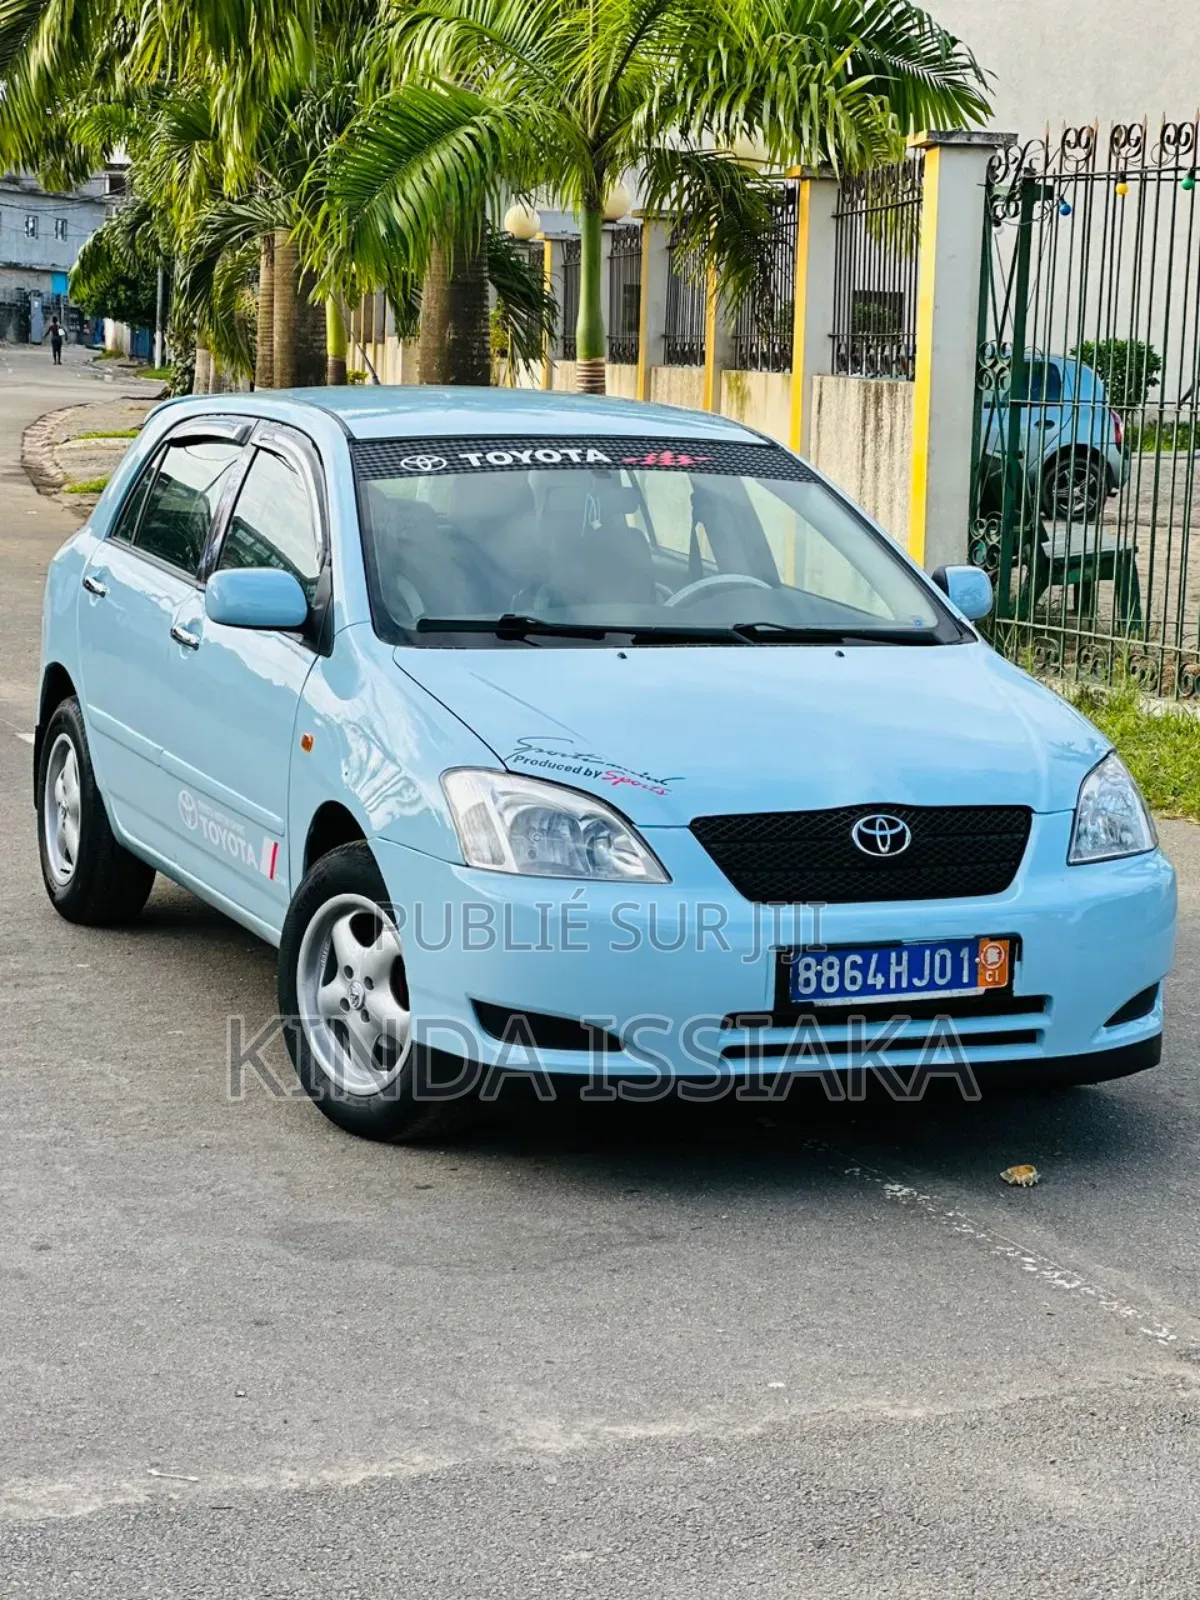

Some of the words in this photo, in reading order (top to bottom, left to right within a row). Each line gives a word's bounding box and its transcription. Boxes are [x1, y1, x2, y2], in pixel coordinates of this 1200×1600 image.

[459, 450, 611, 466] TOYOTA
[513, 755, 580, 775] Produced
[583, 768, 602, 779] by
[602, 770, 672, 795] Sports
[199, 815, 258, 871] TOYOTA
[798, 946, 970, 994] 8864HJ01
